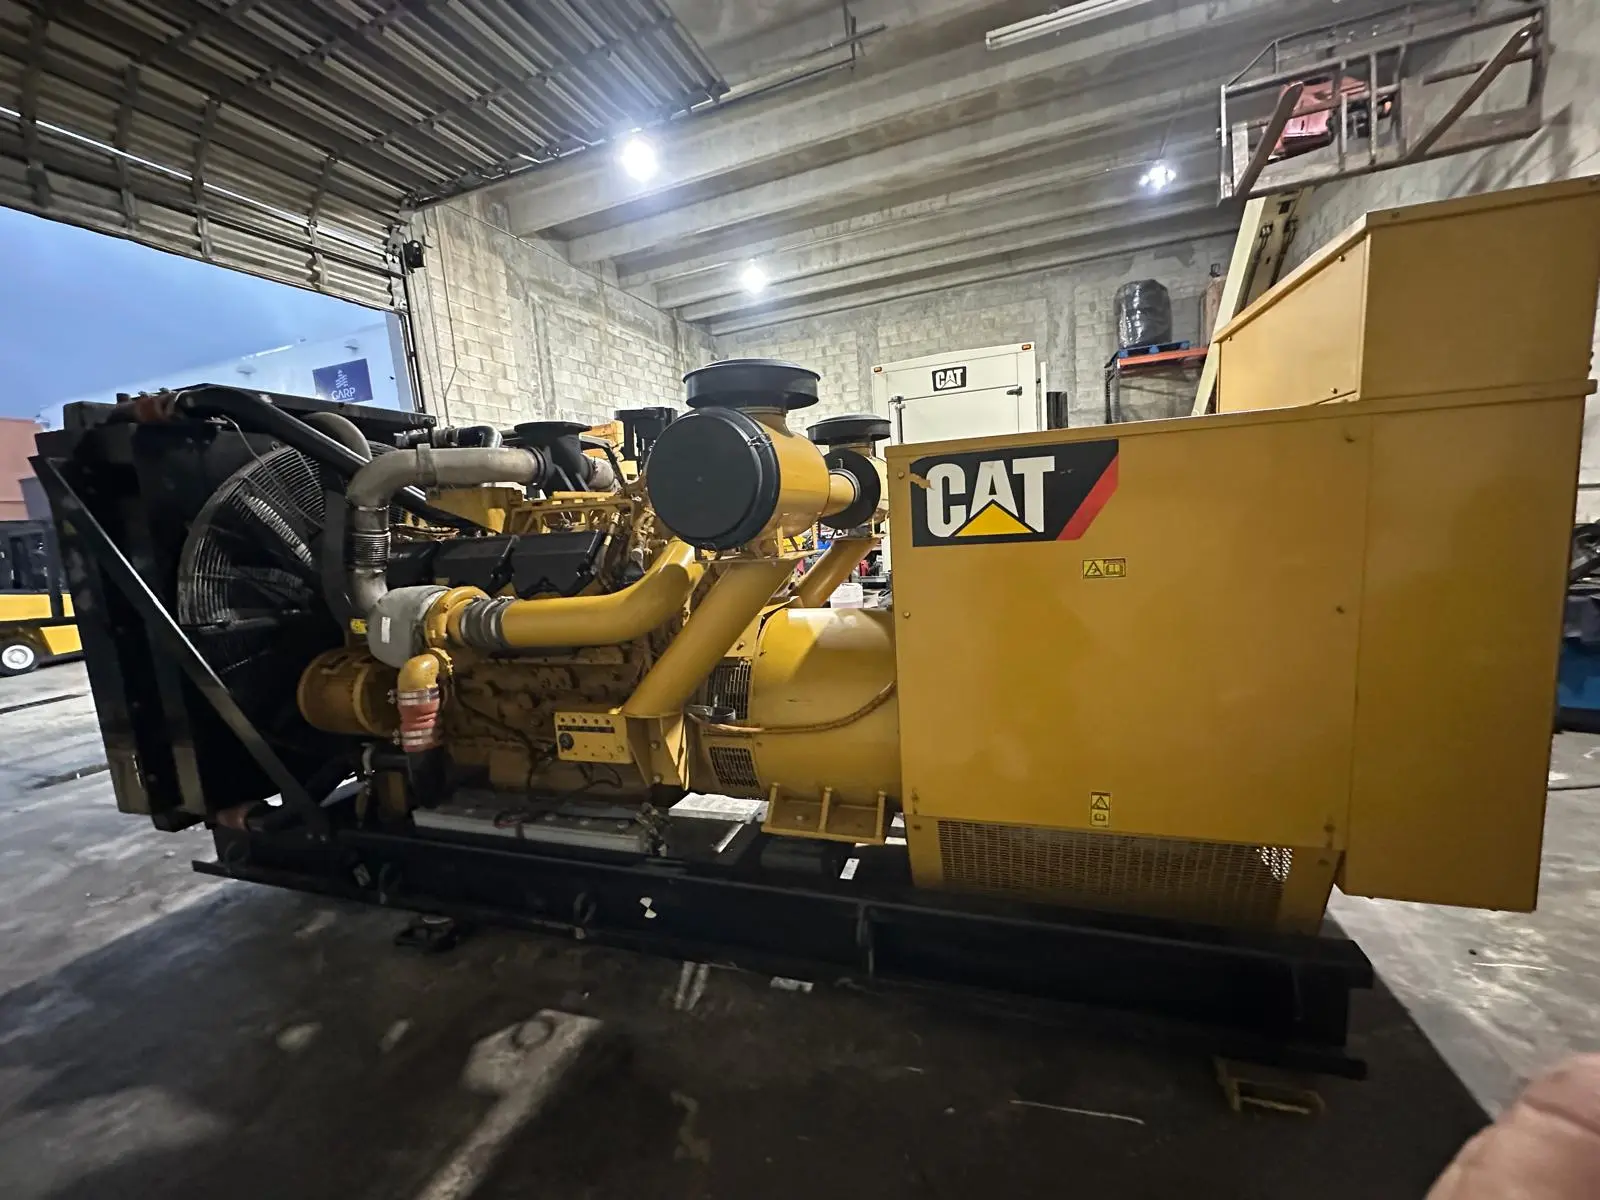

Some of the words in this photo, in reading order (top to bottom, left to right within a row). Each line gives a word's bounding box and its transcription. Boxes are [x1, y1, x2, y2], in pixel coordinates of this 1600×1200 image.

[935, 368, 964, 390] CAT
[331, 387, 356, 401] GARP
[926, 456, 1056, 538] CAT
